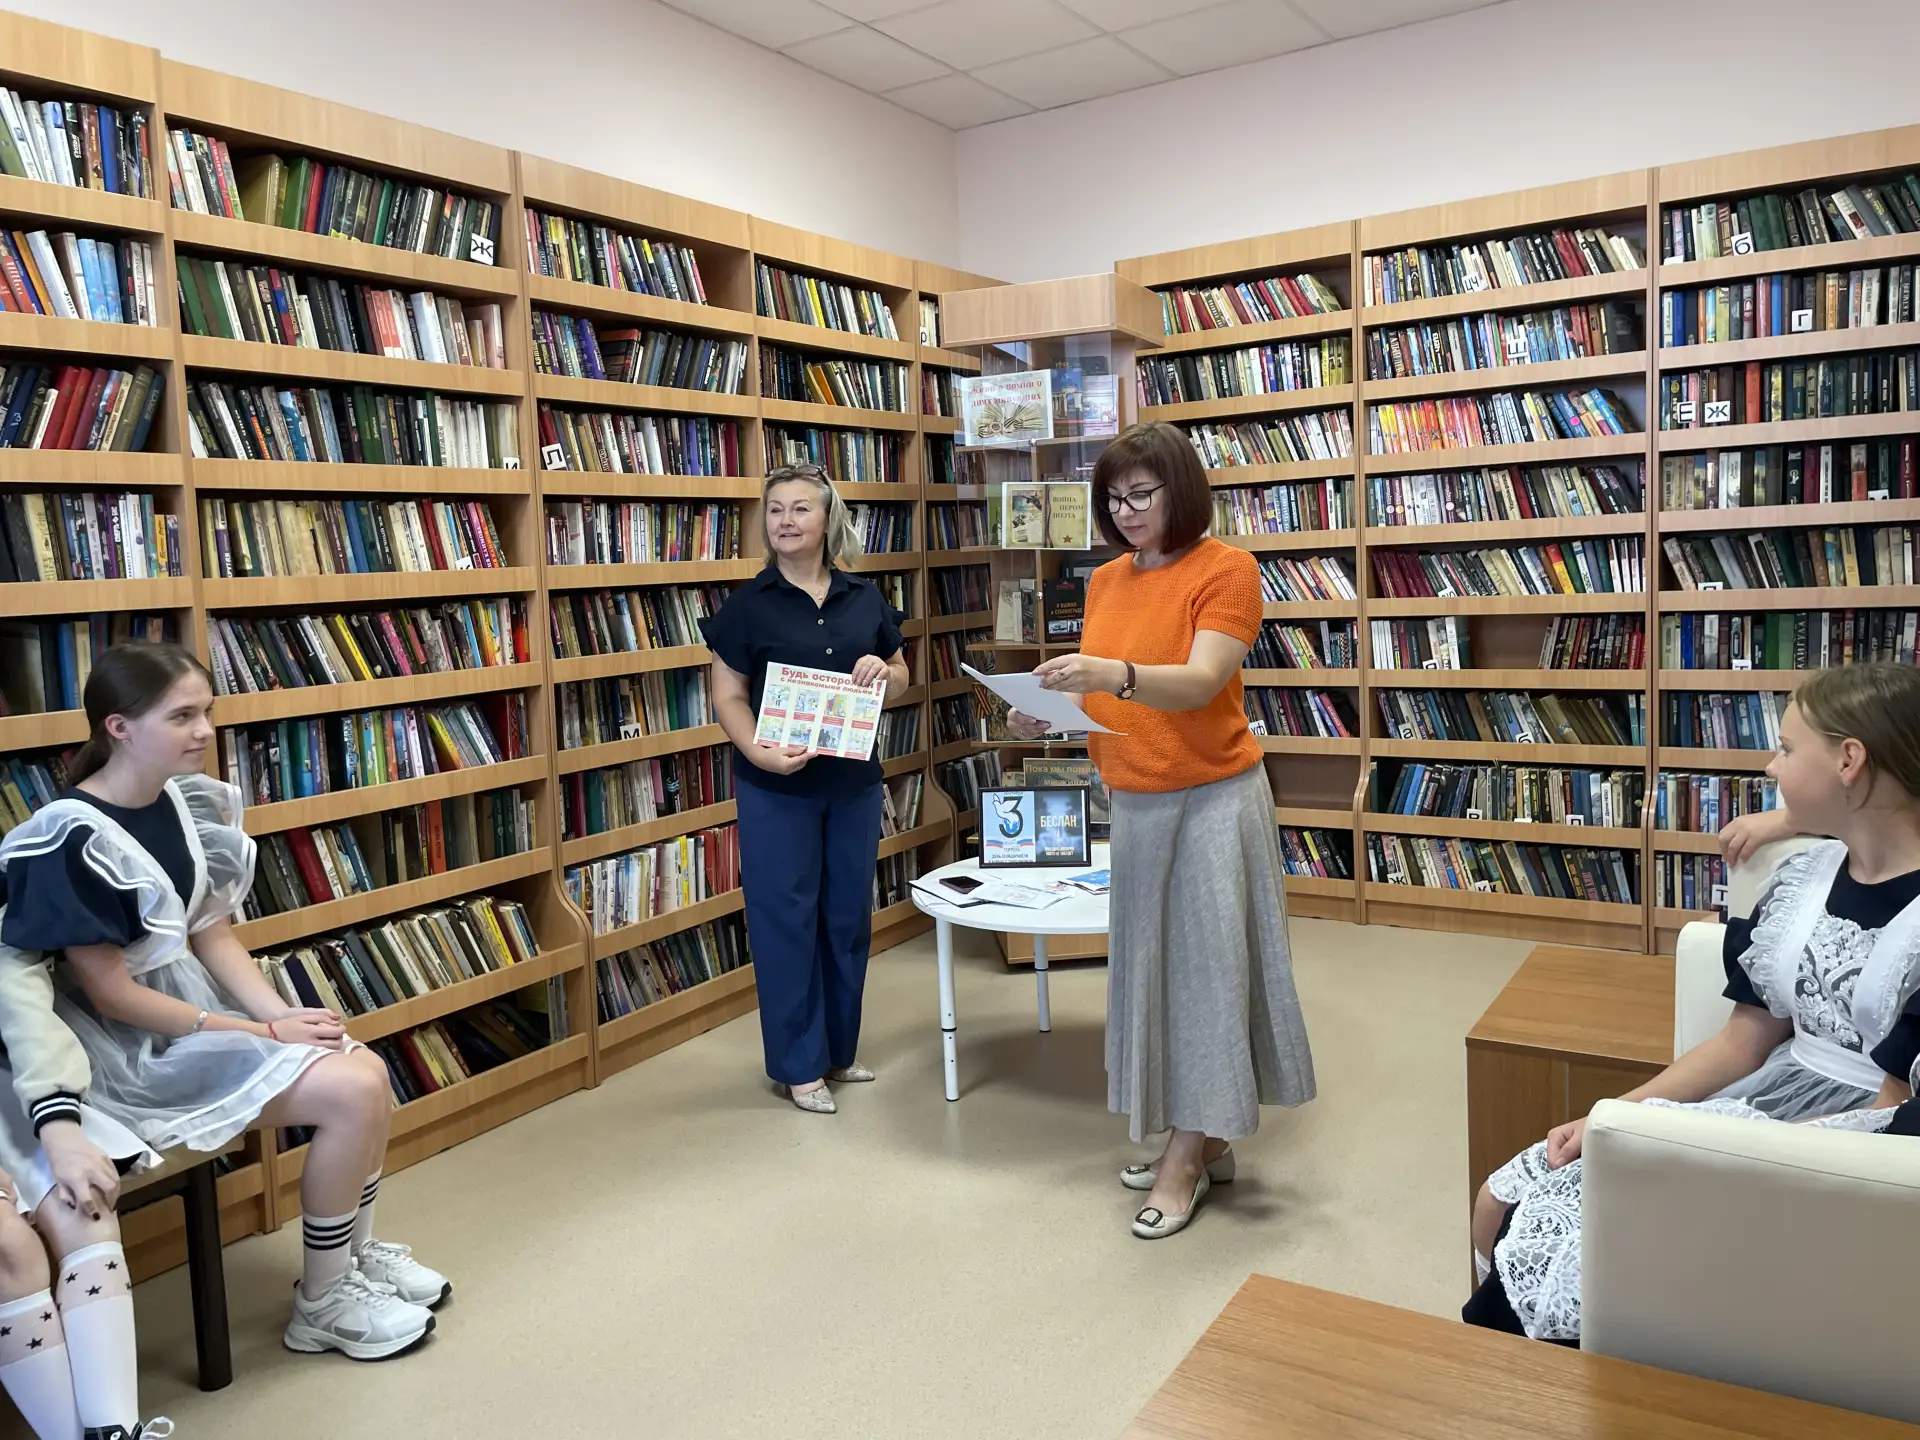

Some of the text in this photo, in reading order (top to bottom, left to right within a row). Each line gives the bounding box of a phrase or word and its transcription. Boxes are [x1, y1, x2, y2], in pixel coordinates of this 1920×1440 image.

[472, 238, 494, 257] Ж
[1797, 313, 1809, 327] Г
[1679, 402, 1693, 421] Е
[1707, 404, 1728, 419] Ж
[1794, 617, 1808, 669] АЛИГУЛА
[781, 666, 809, 680] Будь
[812, 673, 874, 689] осторон
[786, 678, 841, 691] незнакомыми
[842, 686, 873, 695] людьми
[1025, 764, 1048, 773] Пока
[999, 796, 1024, 838] 3
[1040, 815, 1077, 827] БЕСЛАН
[355, 979, 374, 1008] КРАМЕР
